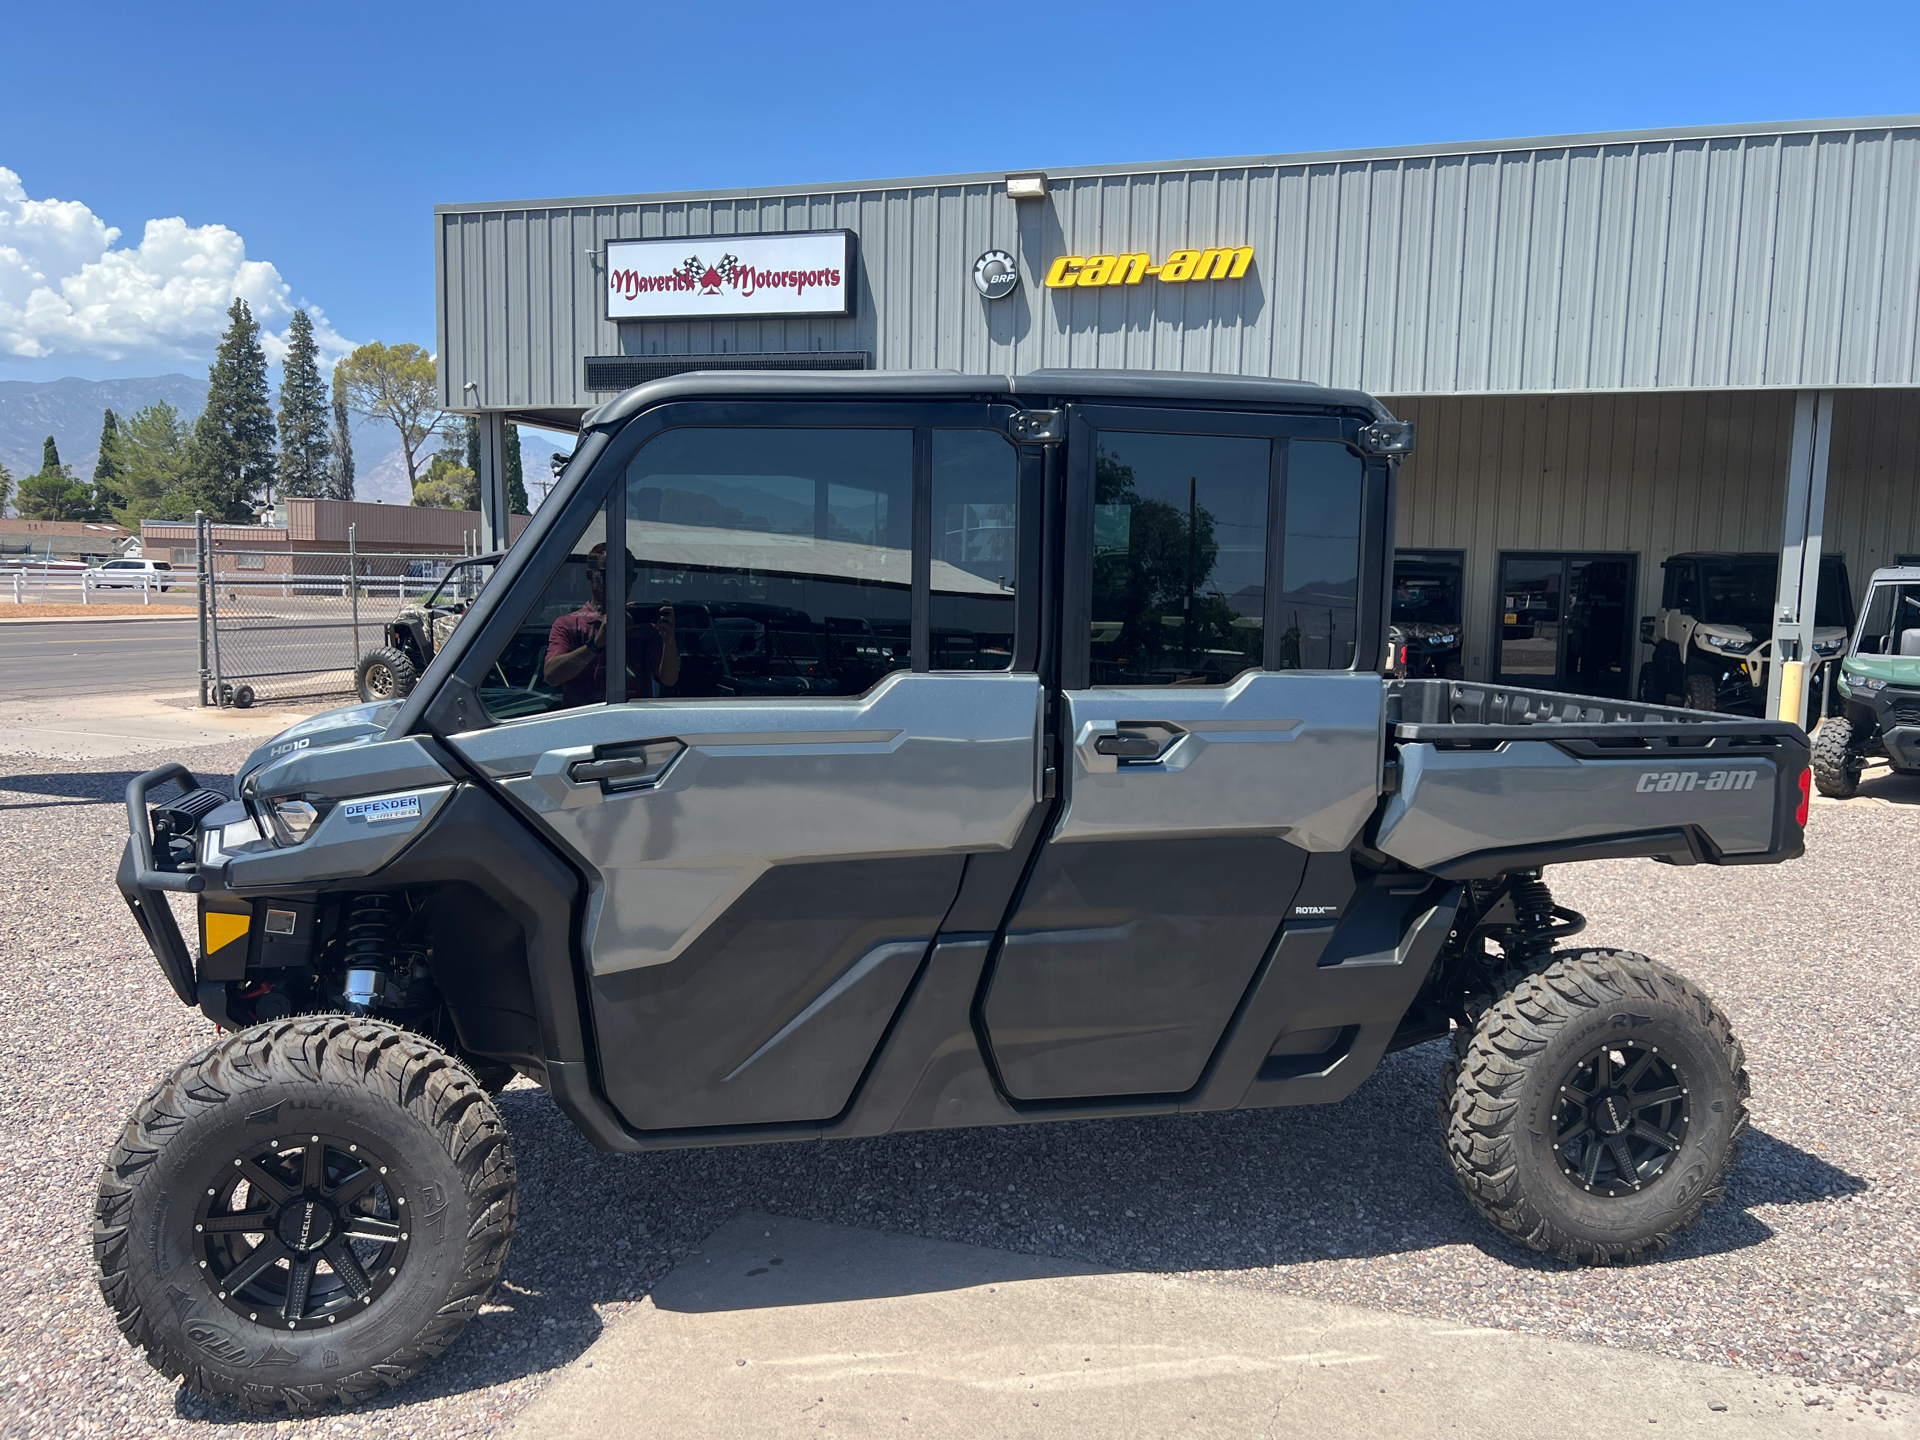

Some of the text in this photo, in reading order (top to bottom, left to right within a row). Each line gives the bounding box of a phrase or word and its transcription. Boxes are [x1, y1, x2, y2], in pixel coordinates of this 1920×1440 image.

[1044, 245, 1254, 288] can-am
[610, 264, 841, 301] Maverick Motorsports
[990, 273, 1016, 284] BRP
[270, 737, 310, 757] HD10
[1635, 770, 1758, 793] can-am
[346, 797, 417, 815] DEFENDER
[1295, 906, 1325, 914] ROTAX
[1606, 1096, 1623, 1133] RACELINE
[299, 1201, 314, 1251] RACELINE
